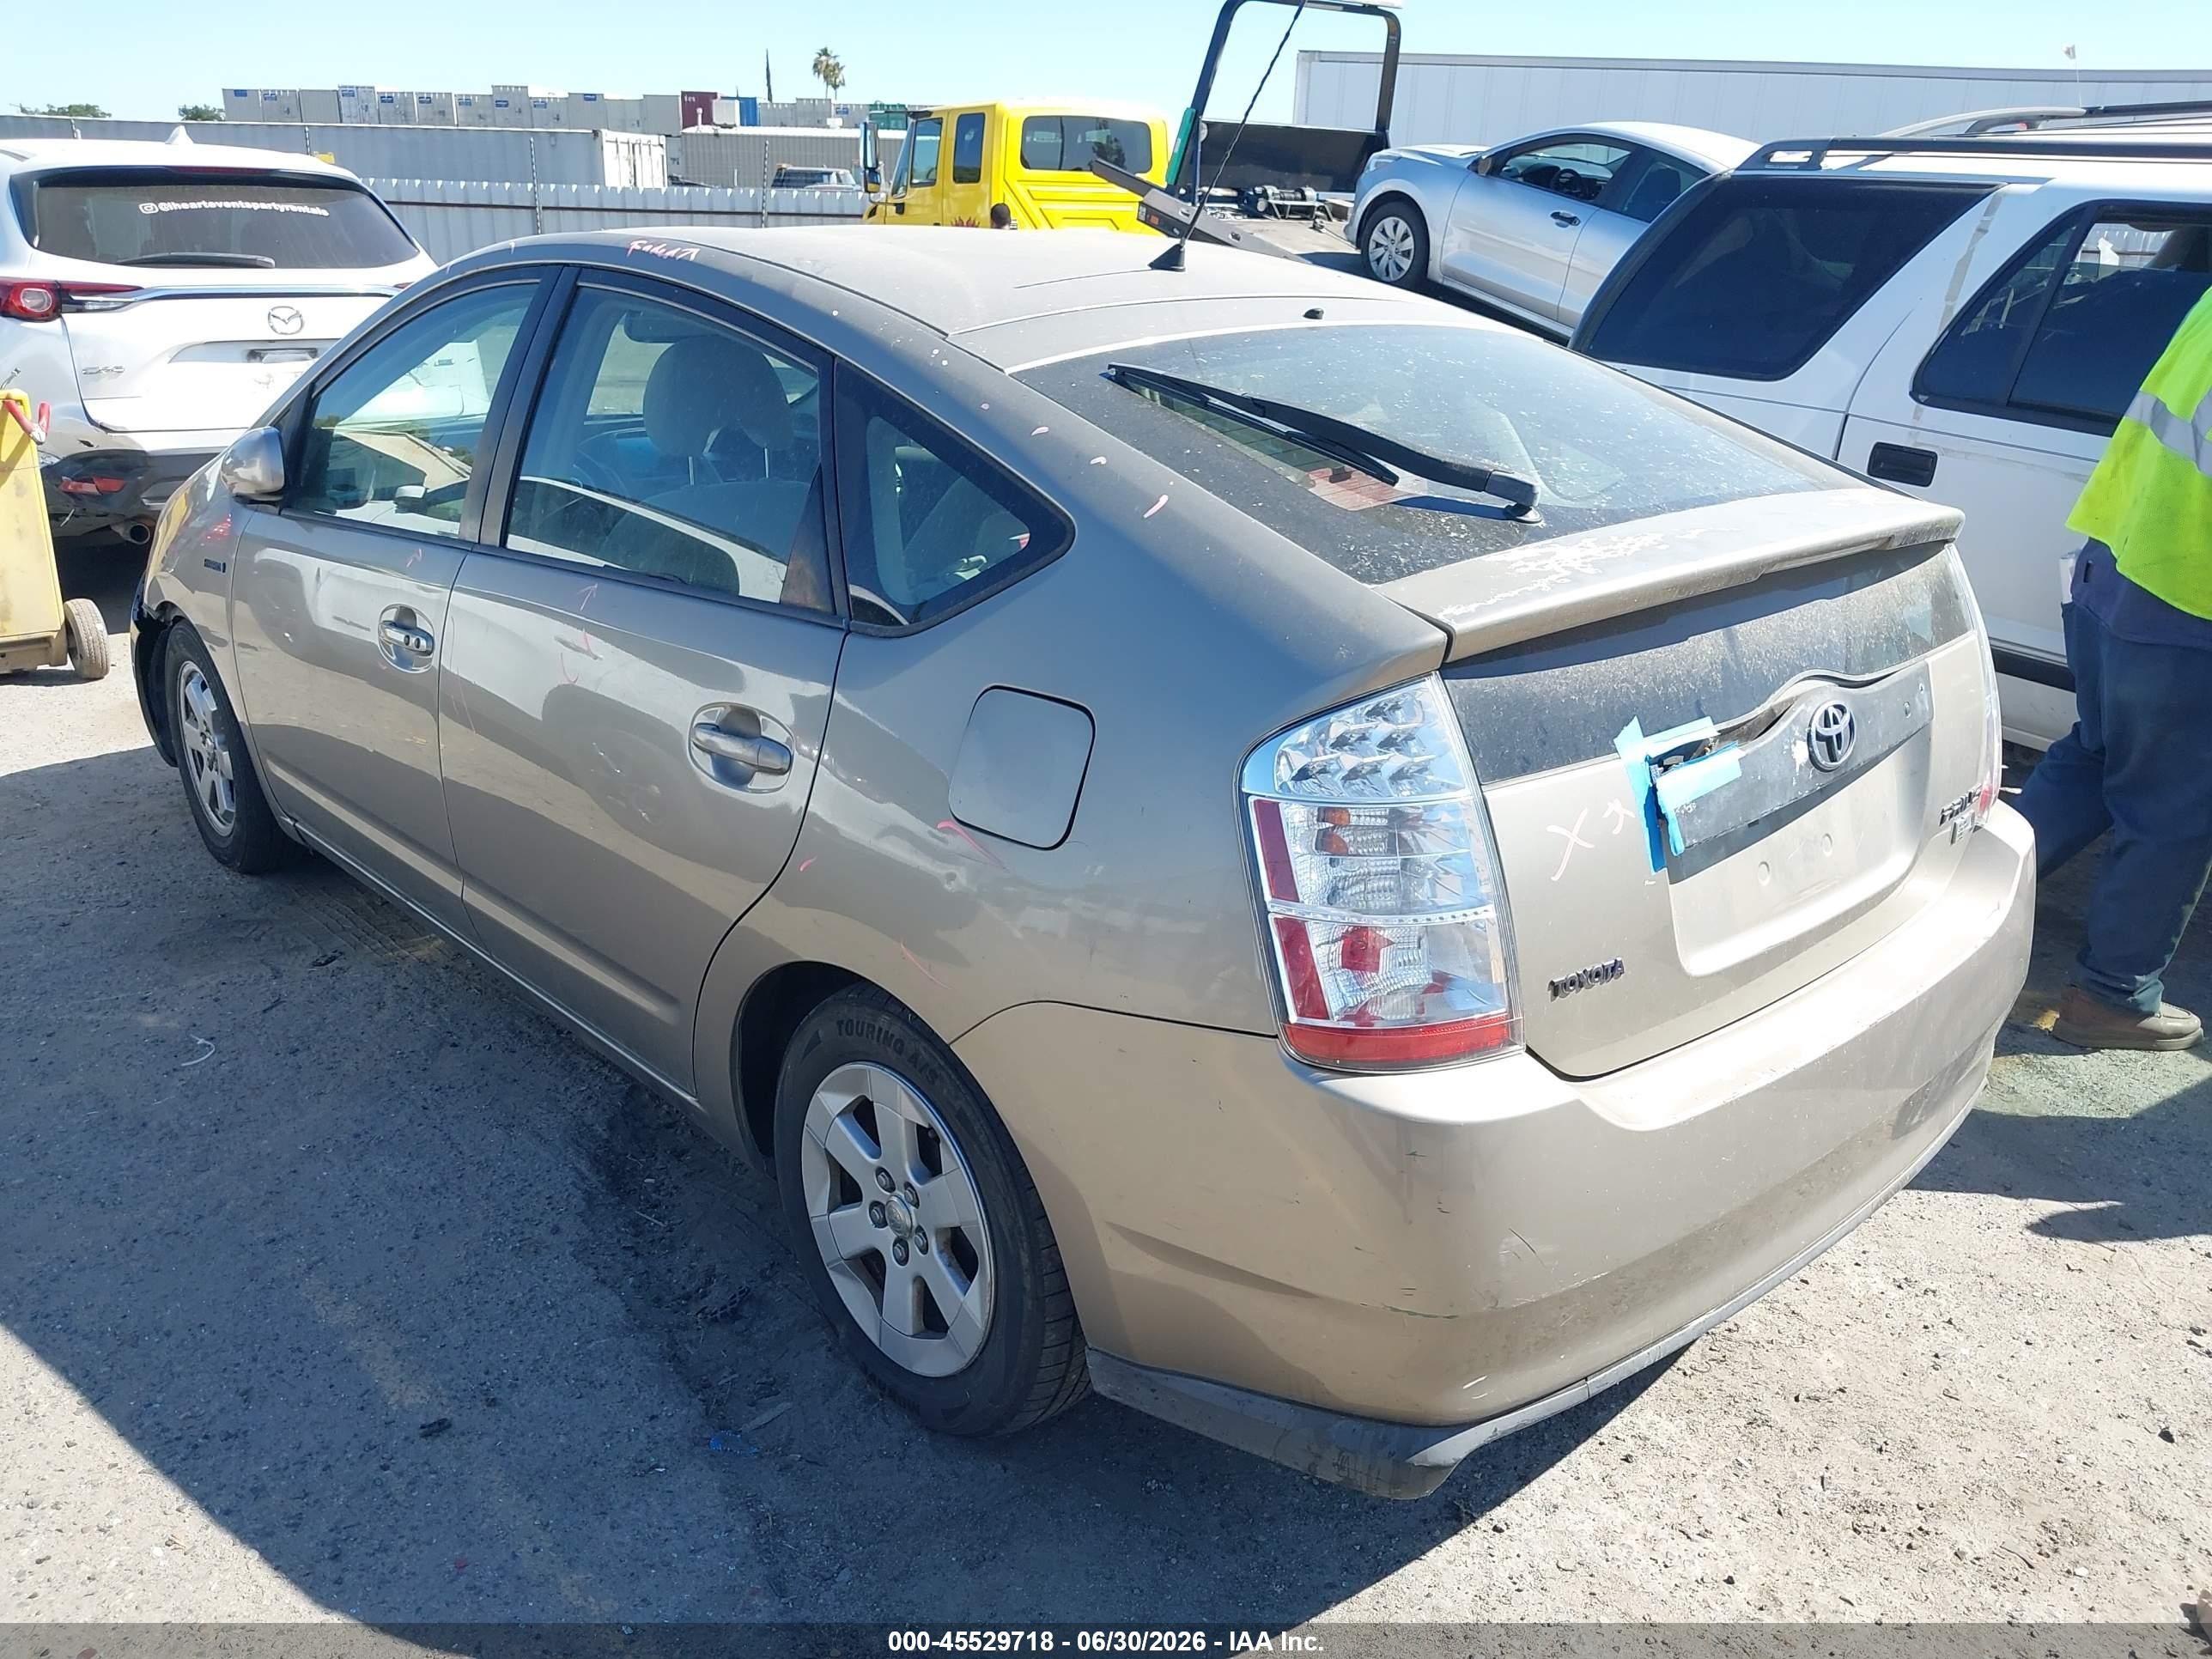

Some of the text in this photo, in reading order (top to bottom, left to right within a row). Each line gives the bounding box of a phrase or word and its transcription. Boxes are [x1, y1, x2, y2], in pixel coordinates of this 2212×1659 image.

[1547, 957, 1625, 1002] TOYOTA
[836, 1019, 939, 1085] TOURING A/S
